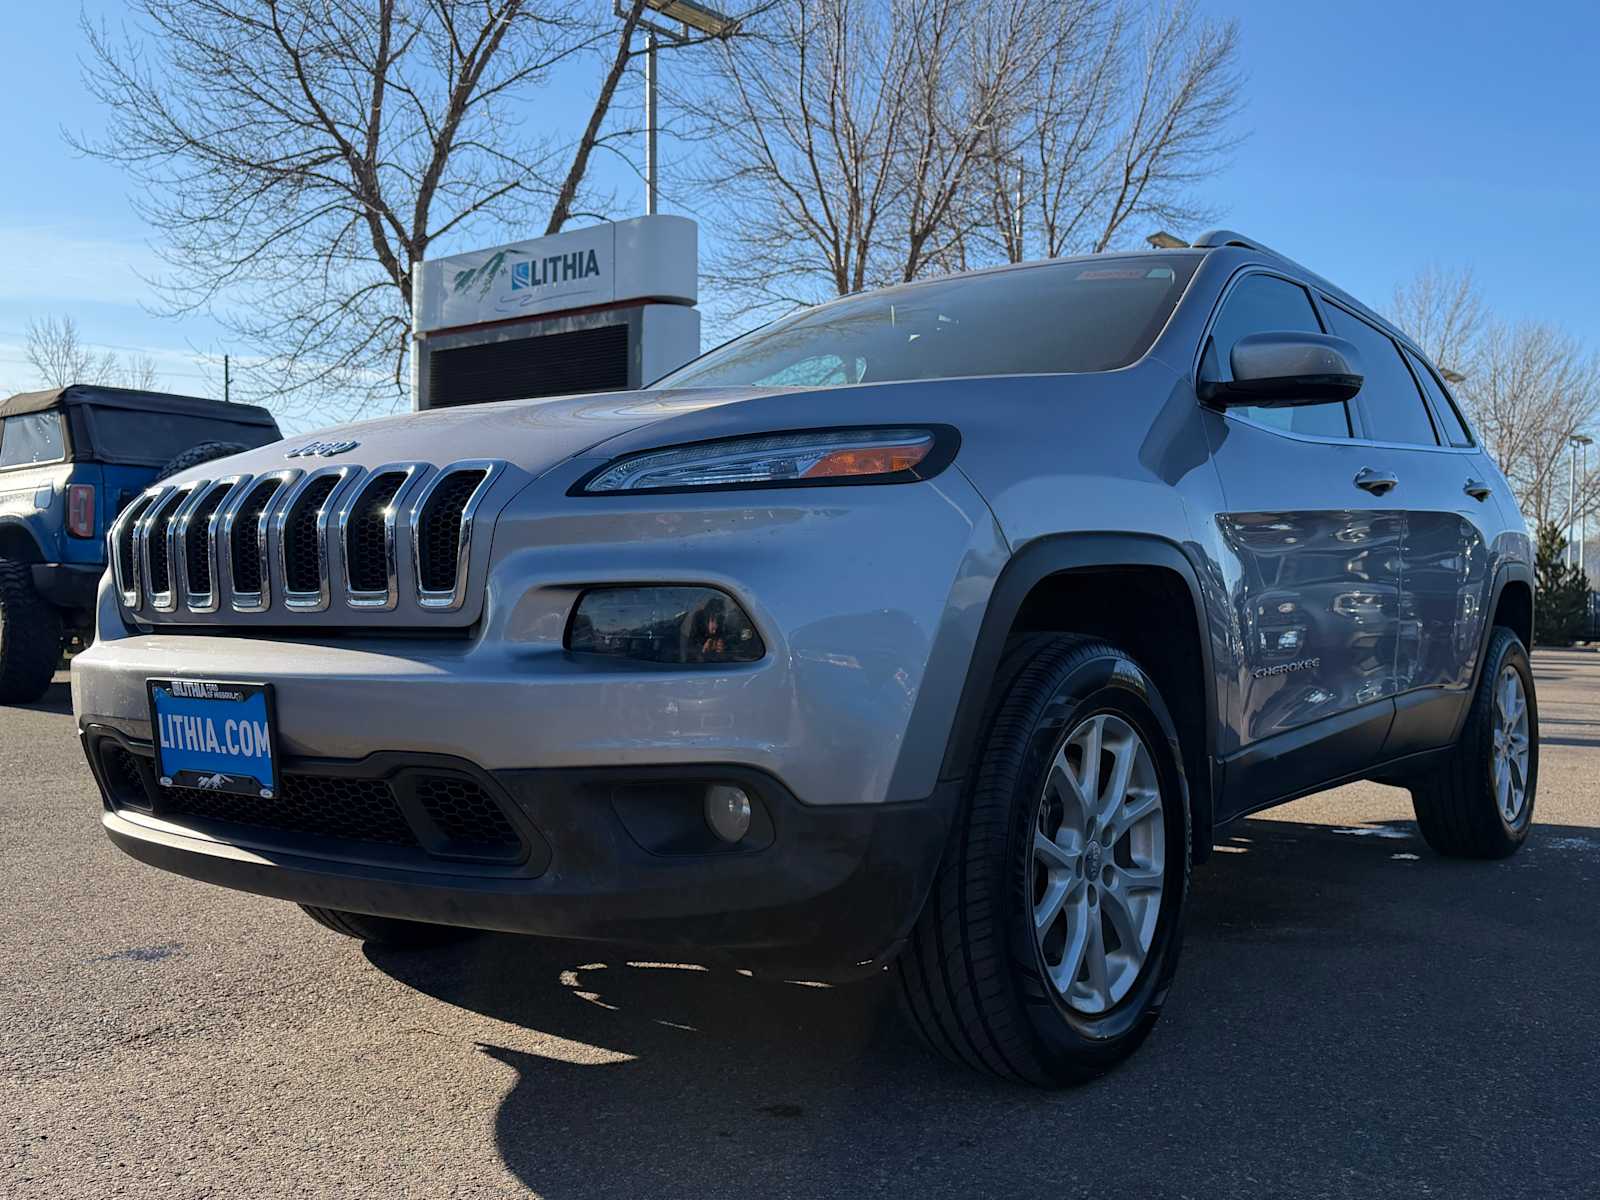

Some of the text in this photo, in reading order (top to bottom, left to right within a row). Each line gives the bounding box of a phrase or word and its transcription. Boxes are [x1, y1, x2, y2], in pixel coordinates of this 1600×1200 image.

[530, 249, 600, 286] LITHIA
[1254, 657, 1321, 678] CHEROKEE
[180, 681, 208, 698] LITHIA
[158, 713, 271, 758] LITHIA.COM
